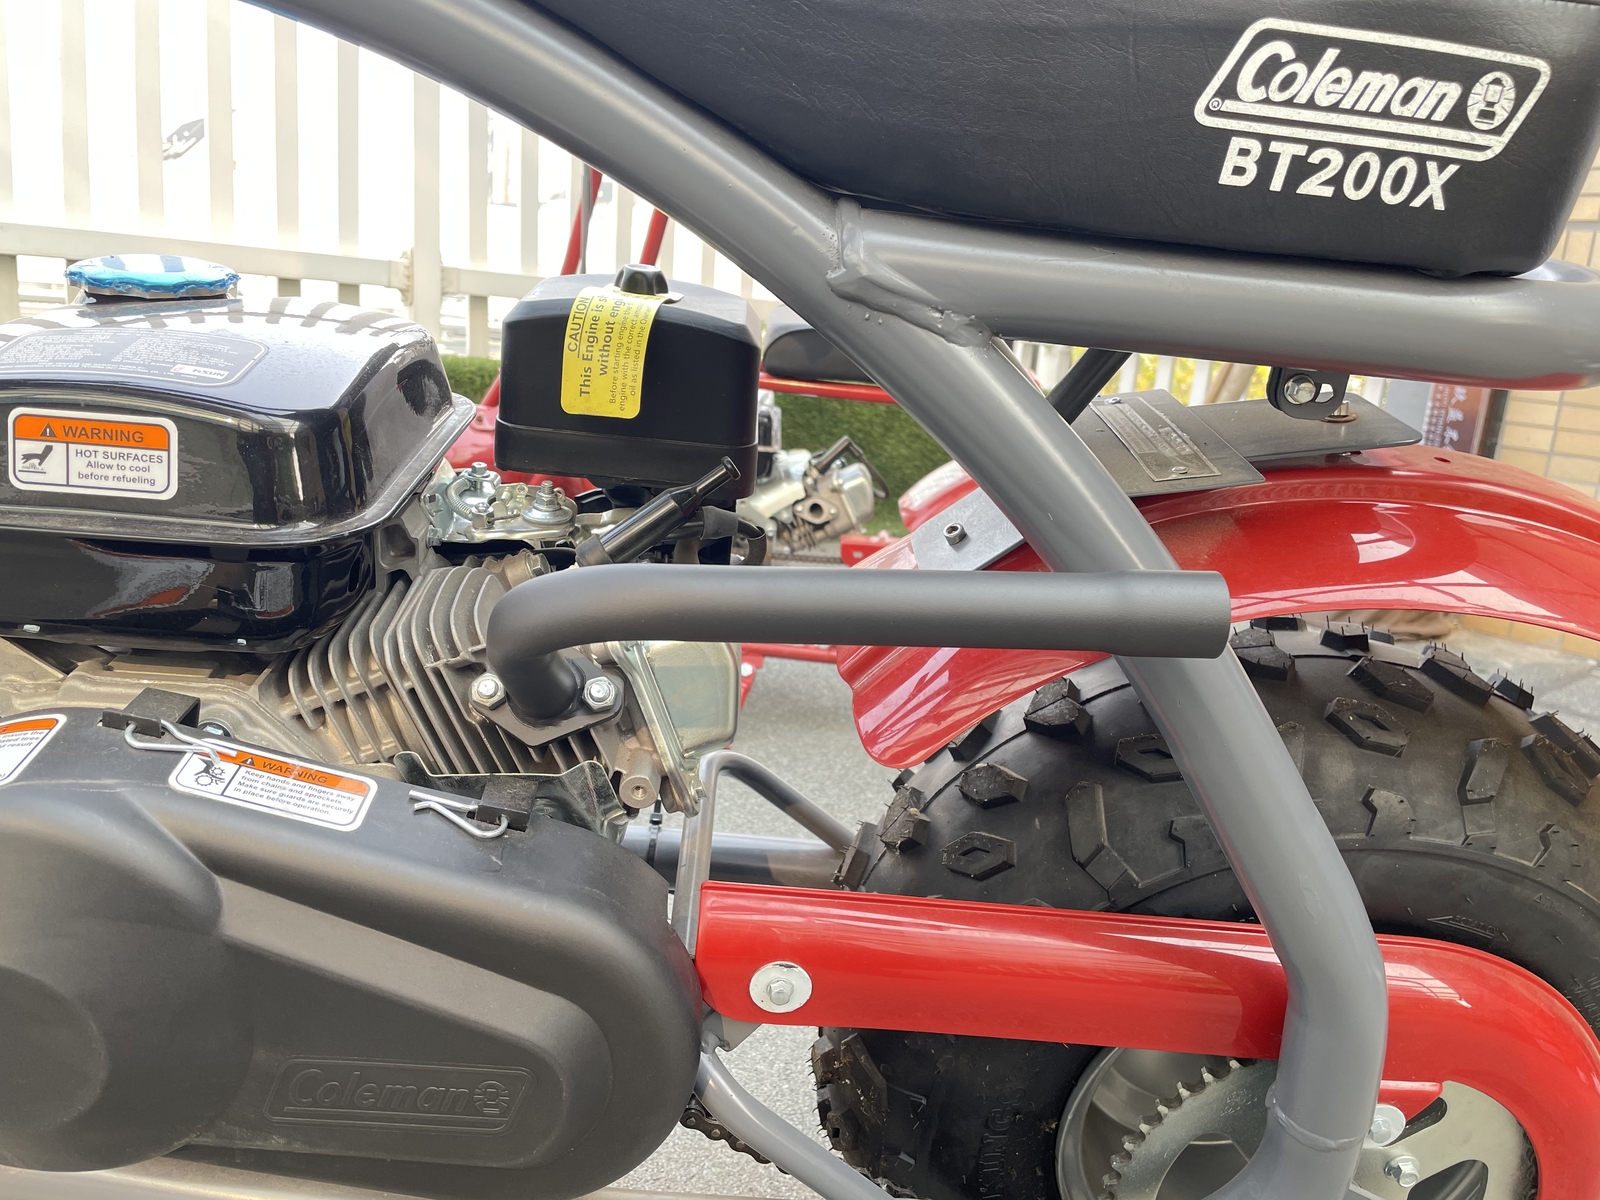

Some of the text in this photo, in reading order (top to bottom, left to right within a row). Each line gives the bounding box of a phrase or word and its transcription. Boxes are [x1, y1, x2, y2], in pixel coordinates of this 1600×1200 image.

[1236, 40, 1463, 122] Coleman
[1217, 136, 1461, 211] BT200X
[592, 304, 604, 313] is
[567, 297, 591, 353] CAUTION
[581, 315, 601, 361] Engine
[617, 315, 629, 341] engine
[626, 319, 637, 344] correct
[636, 327, 646, 338] the
[597, 320, 616, 376] without
[623, 346, 632, 360] the
[634, 339, 642, 348] in
[613, 341, 625, 374] starting
[620, 360, 629, 380] with
[631, 349, 641, 374] listed
[579, 366, 592, 398] This
[609, 376, 618, 404] Before
[632, 374, 638, 384] as
[619, 382, 628, 411] engine
[62, 425, 145, 444] WARNING
[75, 449, 164, 464] HOT SURFACES
[86, 460, 151, 473] Allow to cool
[77, 471, 156, 487] before refueling
[244, 769, 356, 802] Keep hands and fingers away
[262, 761, 328, 784] WARNING
[237, 781, 259, 790] Make
[278, 792, 306, 802] guards
[321, 803, 354, 815] securely
[241, 775, 260, 784] from
[261, 781, 288, 791] chains
[304, 792, 344, 805] sprockets.
[242, 789, 265, 798] place
[265, 795, 292, 805] before
[292, 802, 332, 816] operation.
[288, 1068, 470, 1113] Coleman
